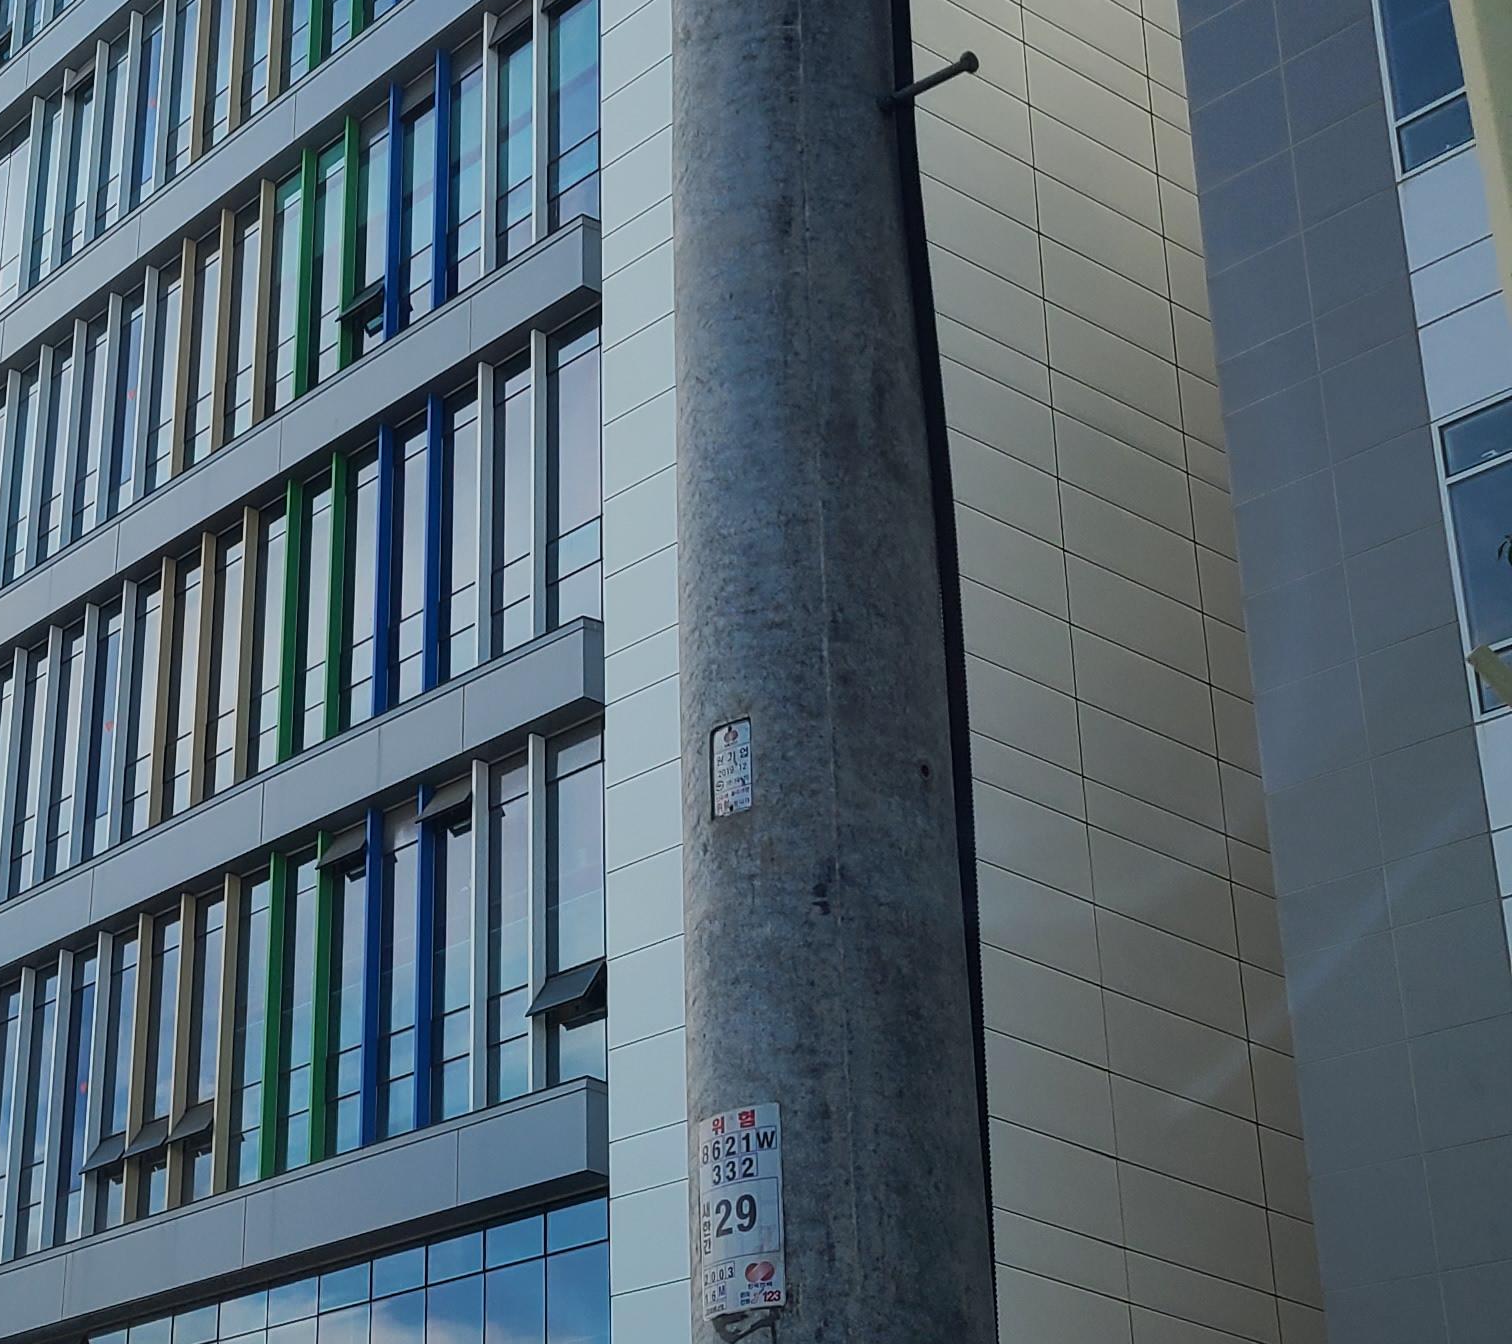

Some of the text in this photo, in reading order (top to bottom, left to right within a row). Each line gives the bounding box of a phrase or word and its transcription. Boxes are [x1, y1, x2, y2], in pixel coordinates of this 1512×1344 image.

[711, 1109, 756, 1135] 위험
[702, 1131, 776, 1166] 8621W
[712, 1158, 755, 1186] 332
[715, 1193, 758, 1239] 29
